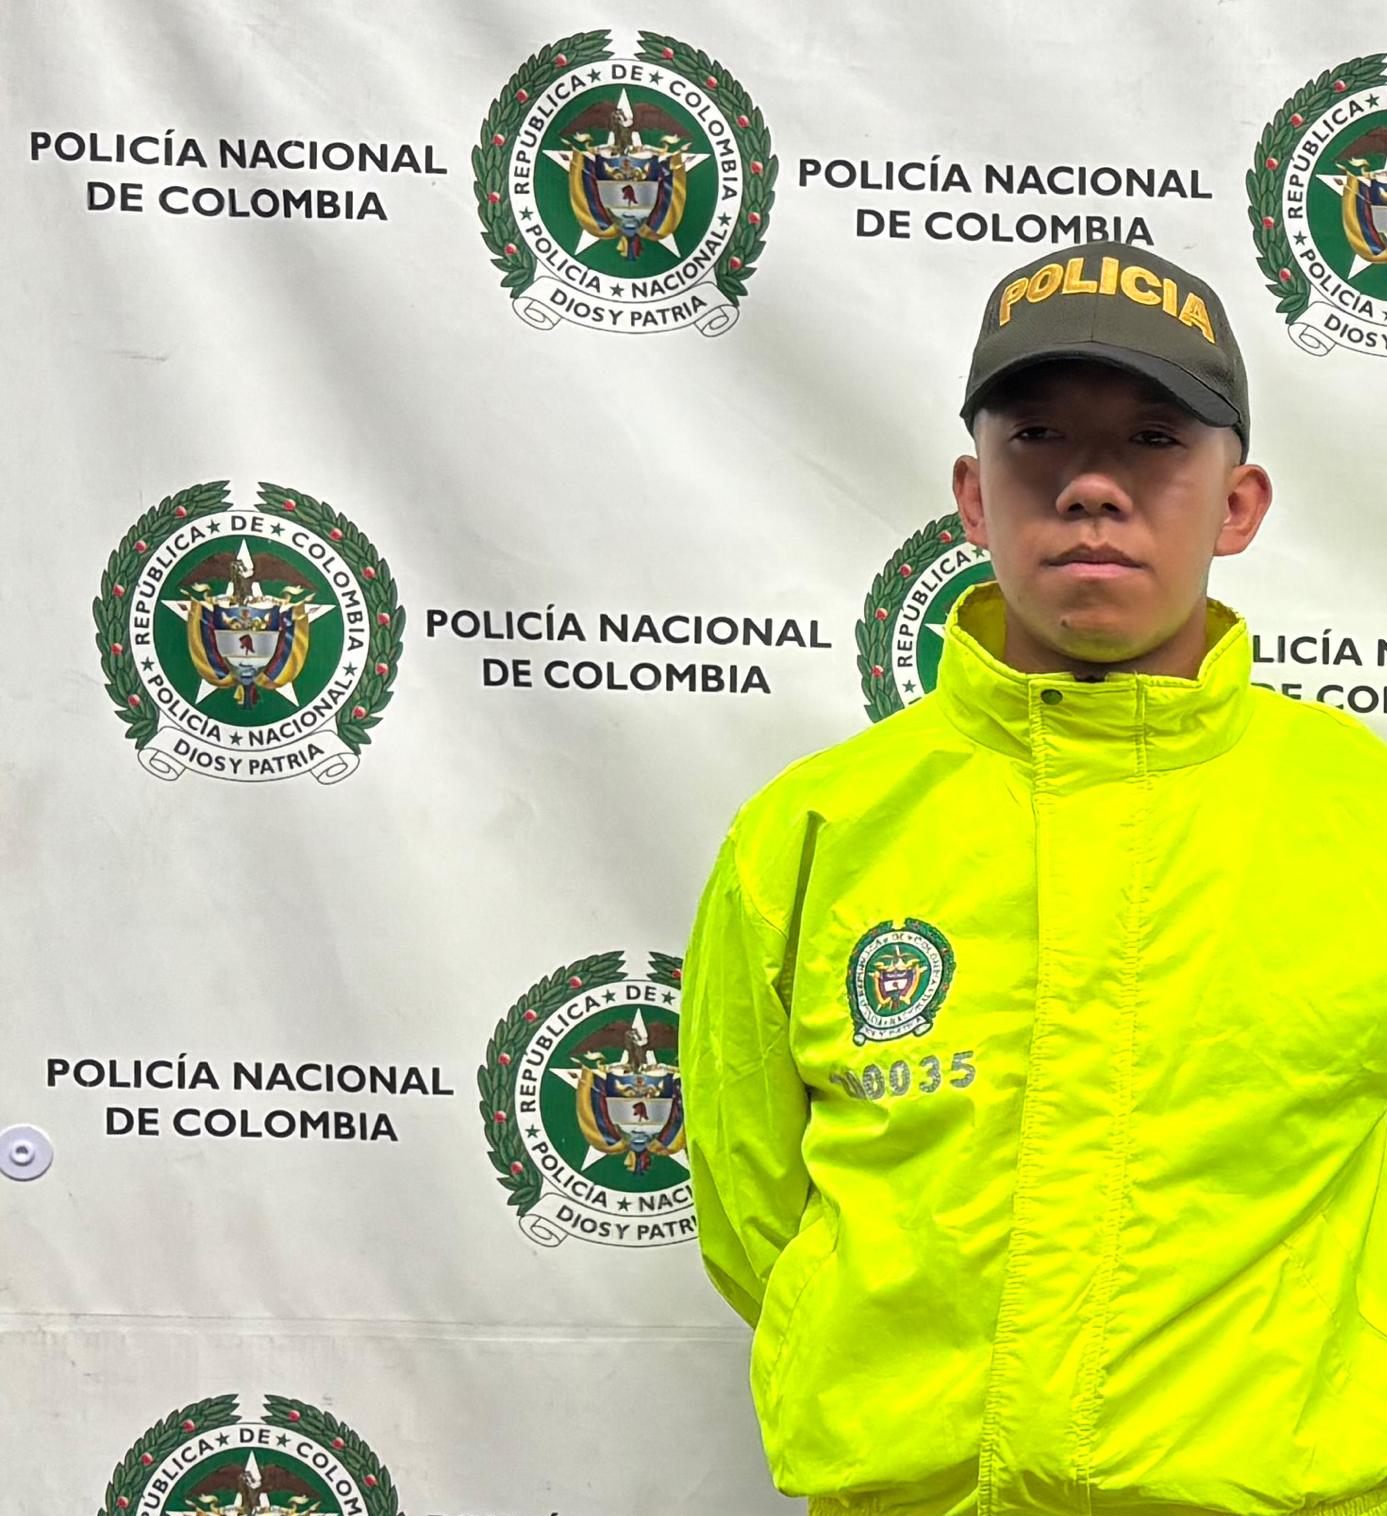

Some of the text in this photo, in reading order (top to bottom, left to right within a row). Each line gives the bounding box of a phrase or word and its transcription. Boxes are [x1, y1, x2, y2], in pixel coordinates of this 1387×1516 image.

[31, 129, 447, 174] POLICÍA NACIONAL
[612, 64, 643, 81] DE
[670, 81, 738, 200] COLOMBIA
[800, 155, 1212, 198] POLICÍA NACIONAL
[88, 182, 387, 220] DE COLOMBIA
[857, 209, 1154, 246] DE COLOMBIA
[632, 230, 727, 298] NACIONAL
[550, 288, 604, 322] DIOS
[631, 296, 707, 326] PATRIA
[1000, 257, 1215, 343] POLICIA
[1324, 314, 1377, 347] DIOS
[427, 604, 831, 648] POLICÍA NACIONAL
[1254, 629, 1362, 666] LICÍA
[483, 659, 770, 694] DE COLOMBIA
[48, 1053, 453, 1095] POLICÍA NACIONAL
[107, 1107, 398, 1141] DE COLOMBIA
